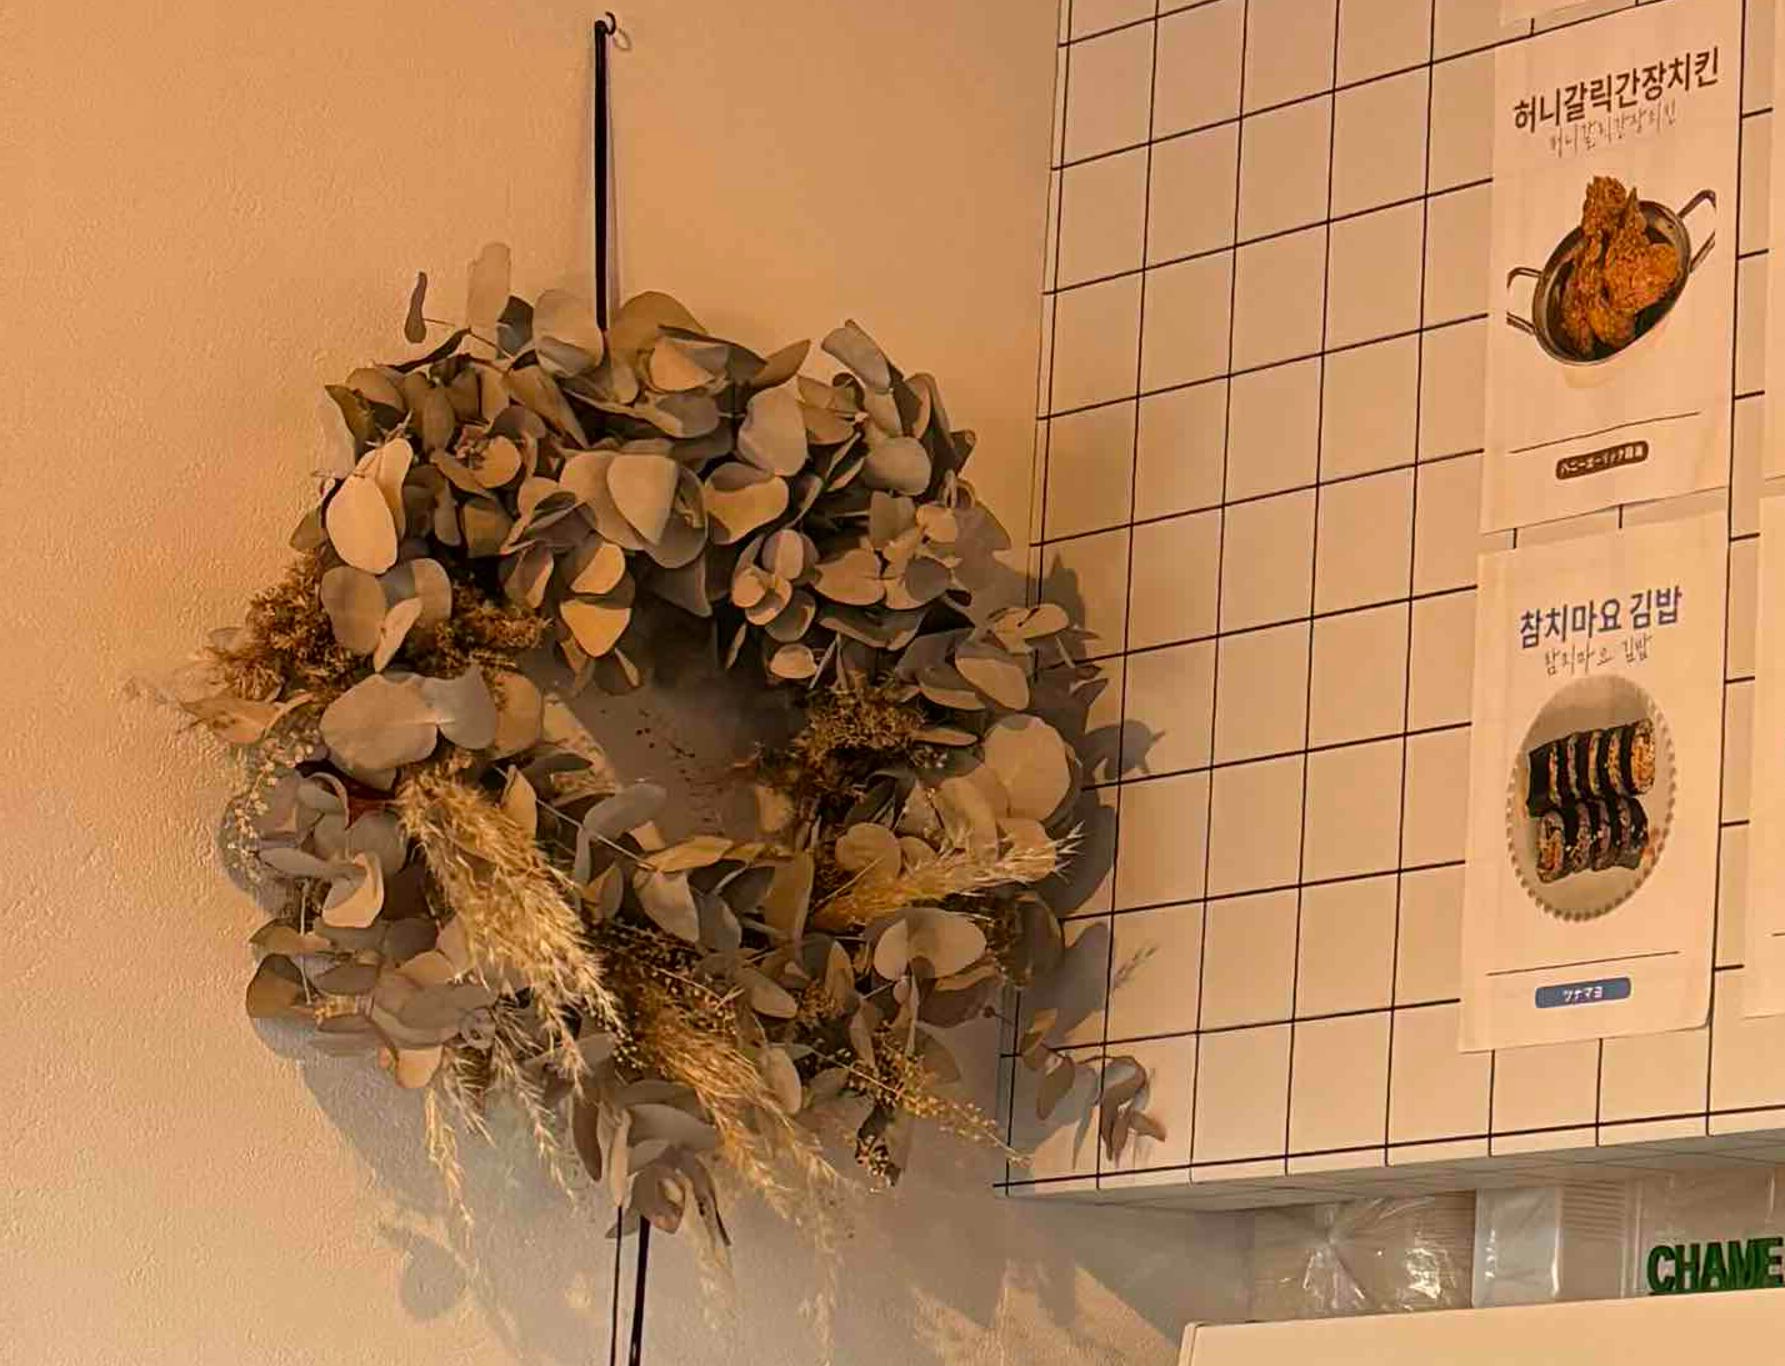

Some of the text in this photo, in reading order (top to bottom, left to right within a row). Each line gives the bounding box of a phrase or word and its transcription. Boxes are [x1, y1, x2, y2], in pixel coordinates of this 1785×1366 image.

[1513, 45, 1720, 135] 허니갈릭간장치킨
[1519, 584, 1683, 649] 참치마요 김밥
[1647, 1237, 1784, 1293] CHAME
